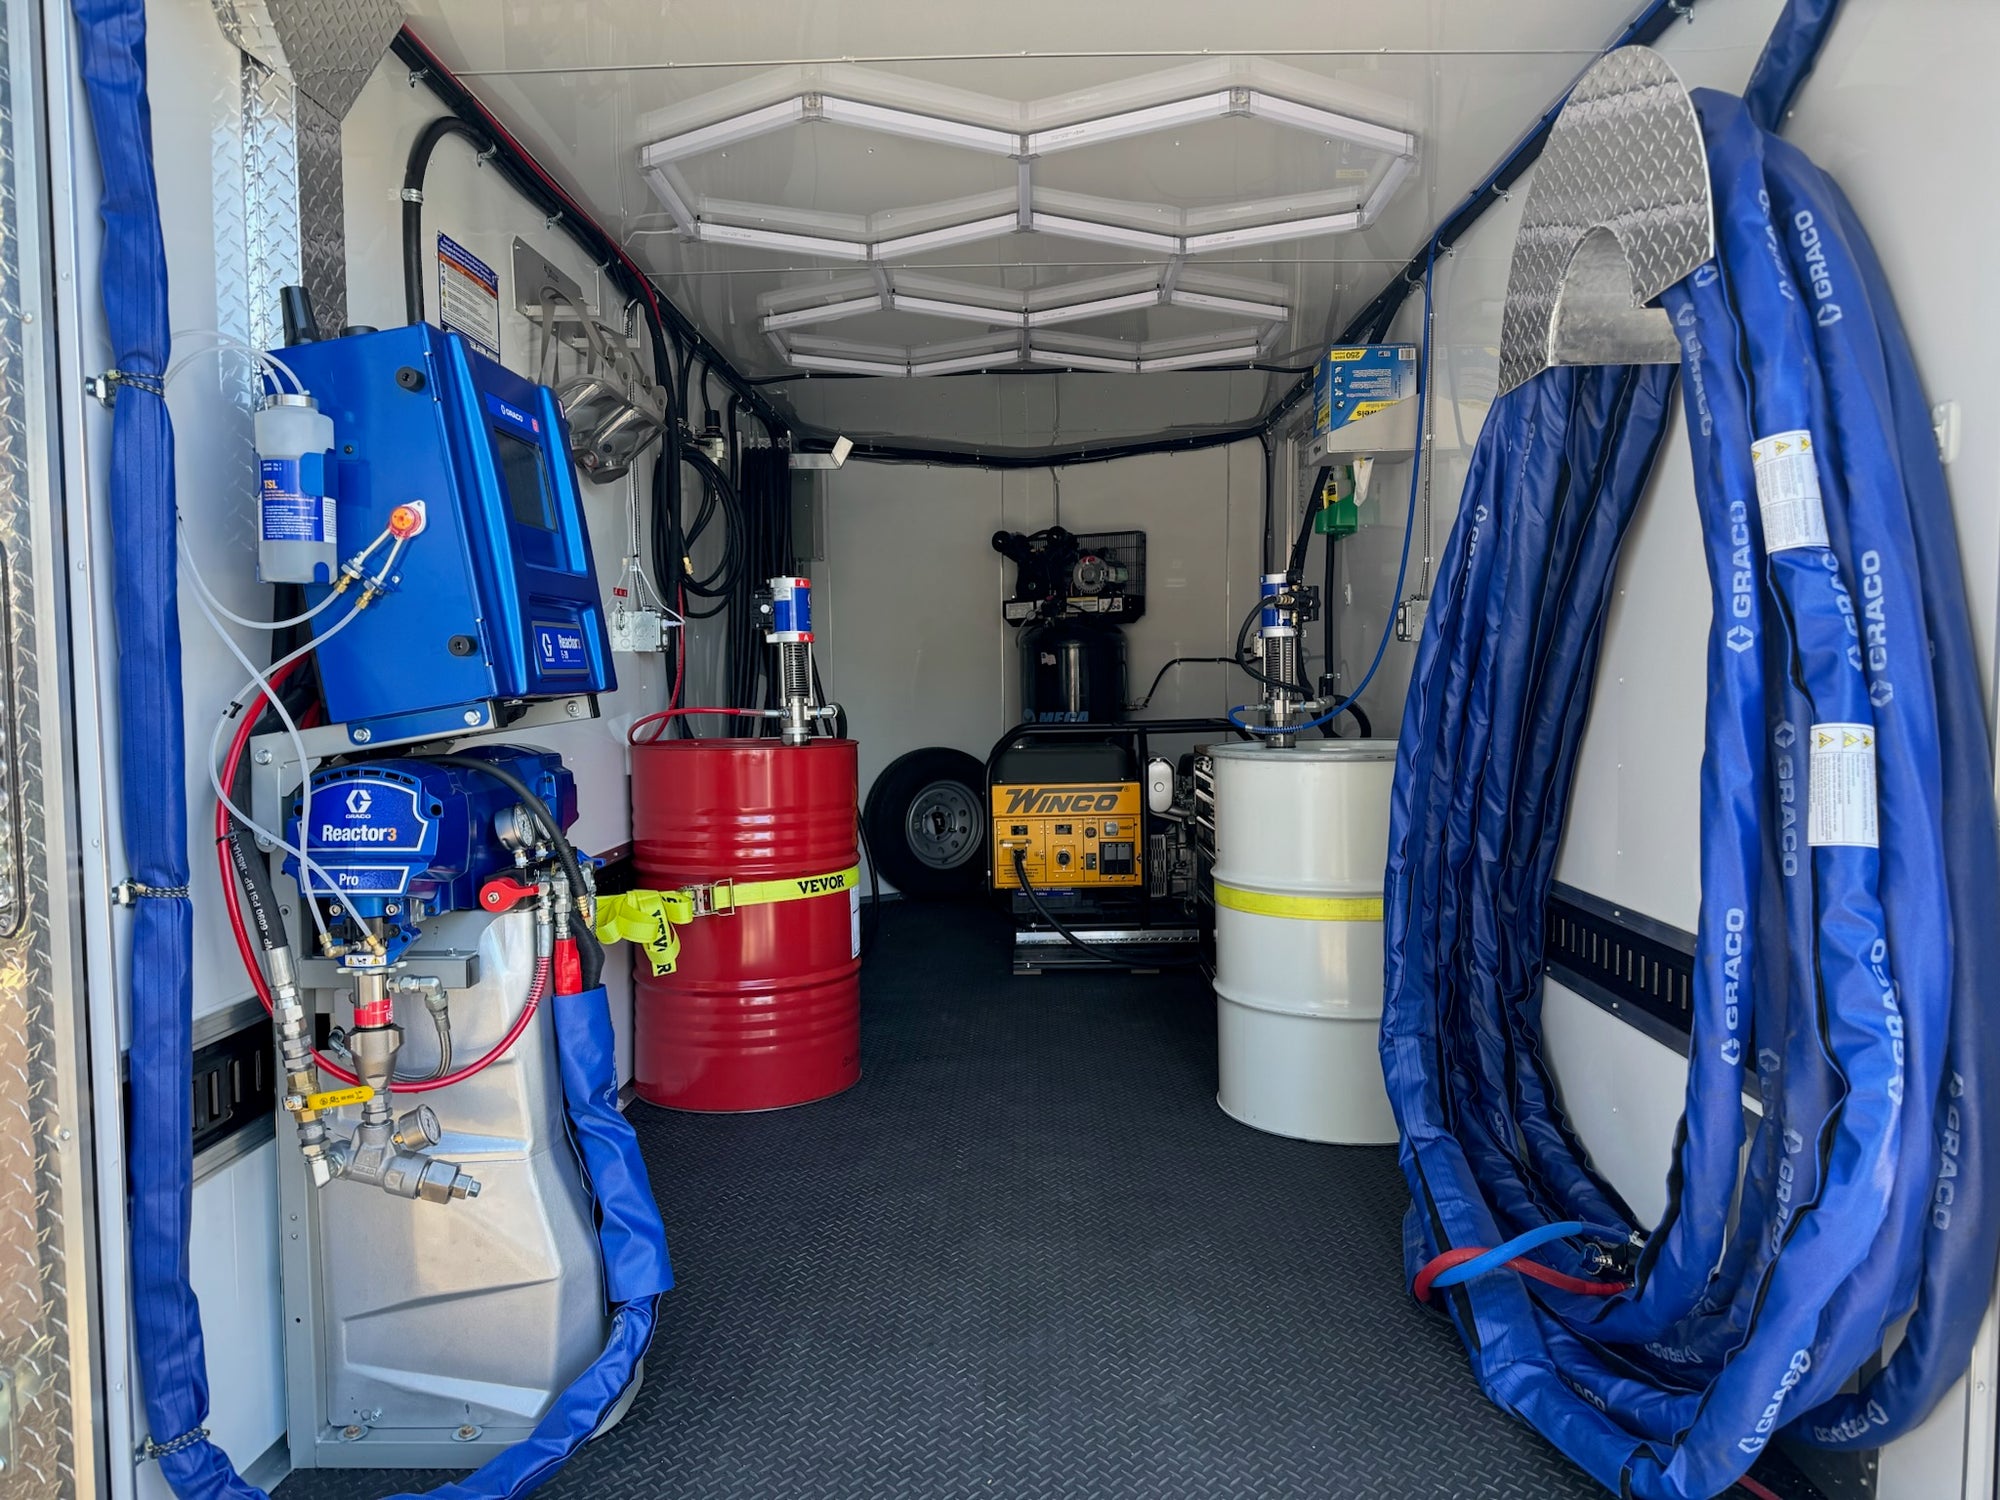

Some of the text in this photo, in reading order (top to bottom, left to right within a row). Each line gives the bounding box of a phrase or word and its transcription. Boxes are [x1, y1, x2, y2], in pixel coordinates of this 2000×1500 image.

[1794, 209, 1833, 300] GRACO
[1346, 352, 1360, 360] 250
[505, 408, 523, 422] GRACO
[264, 480, 278, 489] TSL
[1729, 500, 1752, 618] GRACO
[1821, 552, 1858, 638] GRAC
[1861, 550, 1887, 671] GRACO
[1006, 786, 1124, 814] WINCO
[1777, 754, 1798, 877] GRACO
[322, 824, 398, 842] Reactor3
[244, 878, 254, 889] BP
[339, 873, 359, 886] Pro
[797, 874, 846, 894] VEVOR
[250, 892, 260, 908] PSI
[256, 908, 268, 930] 6090
[1724, 908, 1744, 1030] GRACO
[1870, 938, 1904, 1066] GRACO
[1933, 1104, 1960, 1231] GRACO
[1771, 1158, 1795, 1255] GRACO
